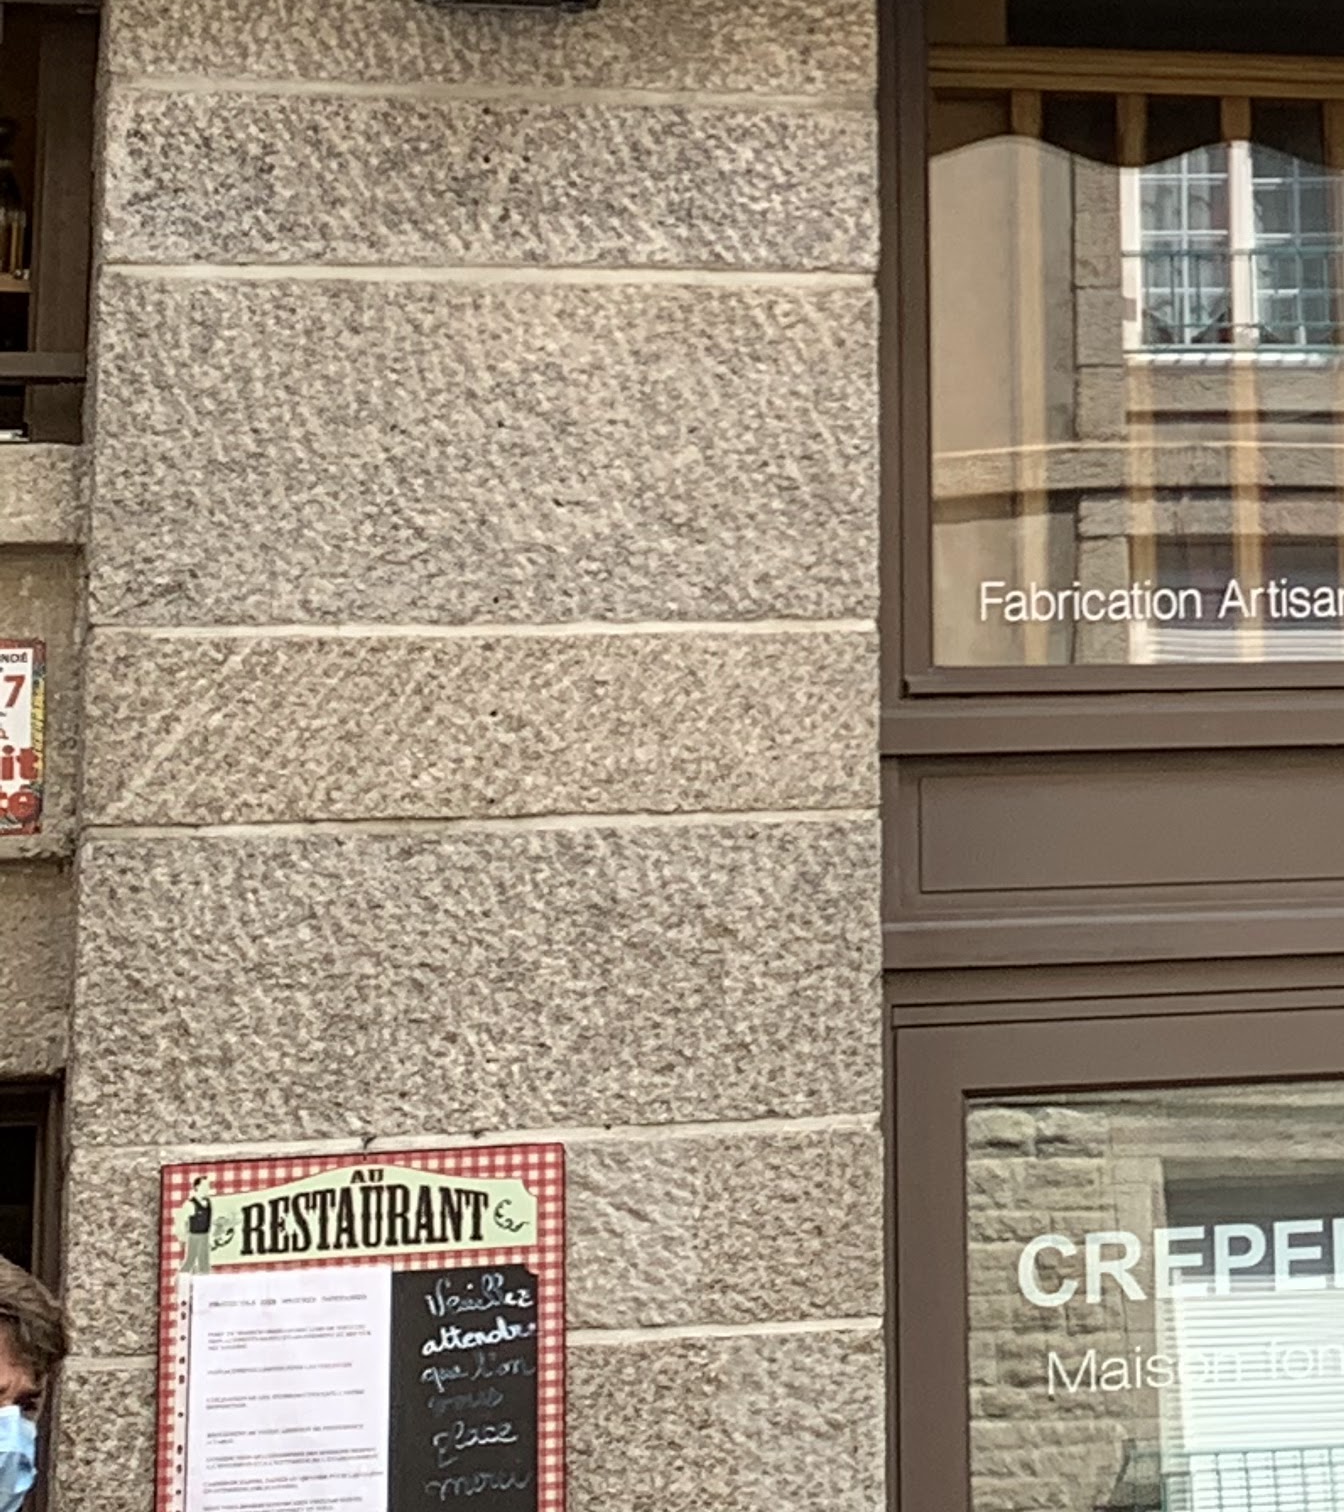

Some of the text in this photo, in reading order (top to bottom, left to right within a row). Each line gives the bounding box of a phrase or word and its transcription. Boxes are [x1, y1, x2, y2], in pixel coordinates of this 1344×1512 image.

[979, 579, 1200, 622] Fabrication
[350, 1168, 385, 1184] AU
[240, 1183, 489, 1257] RESTAURANT
[1046, 1344, 1244, 1395] Maison
